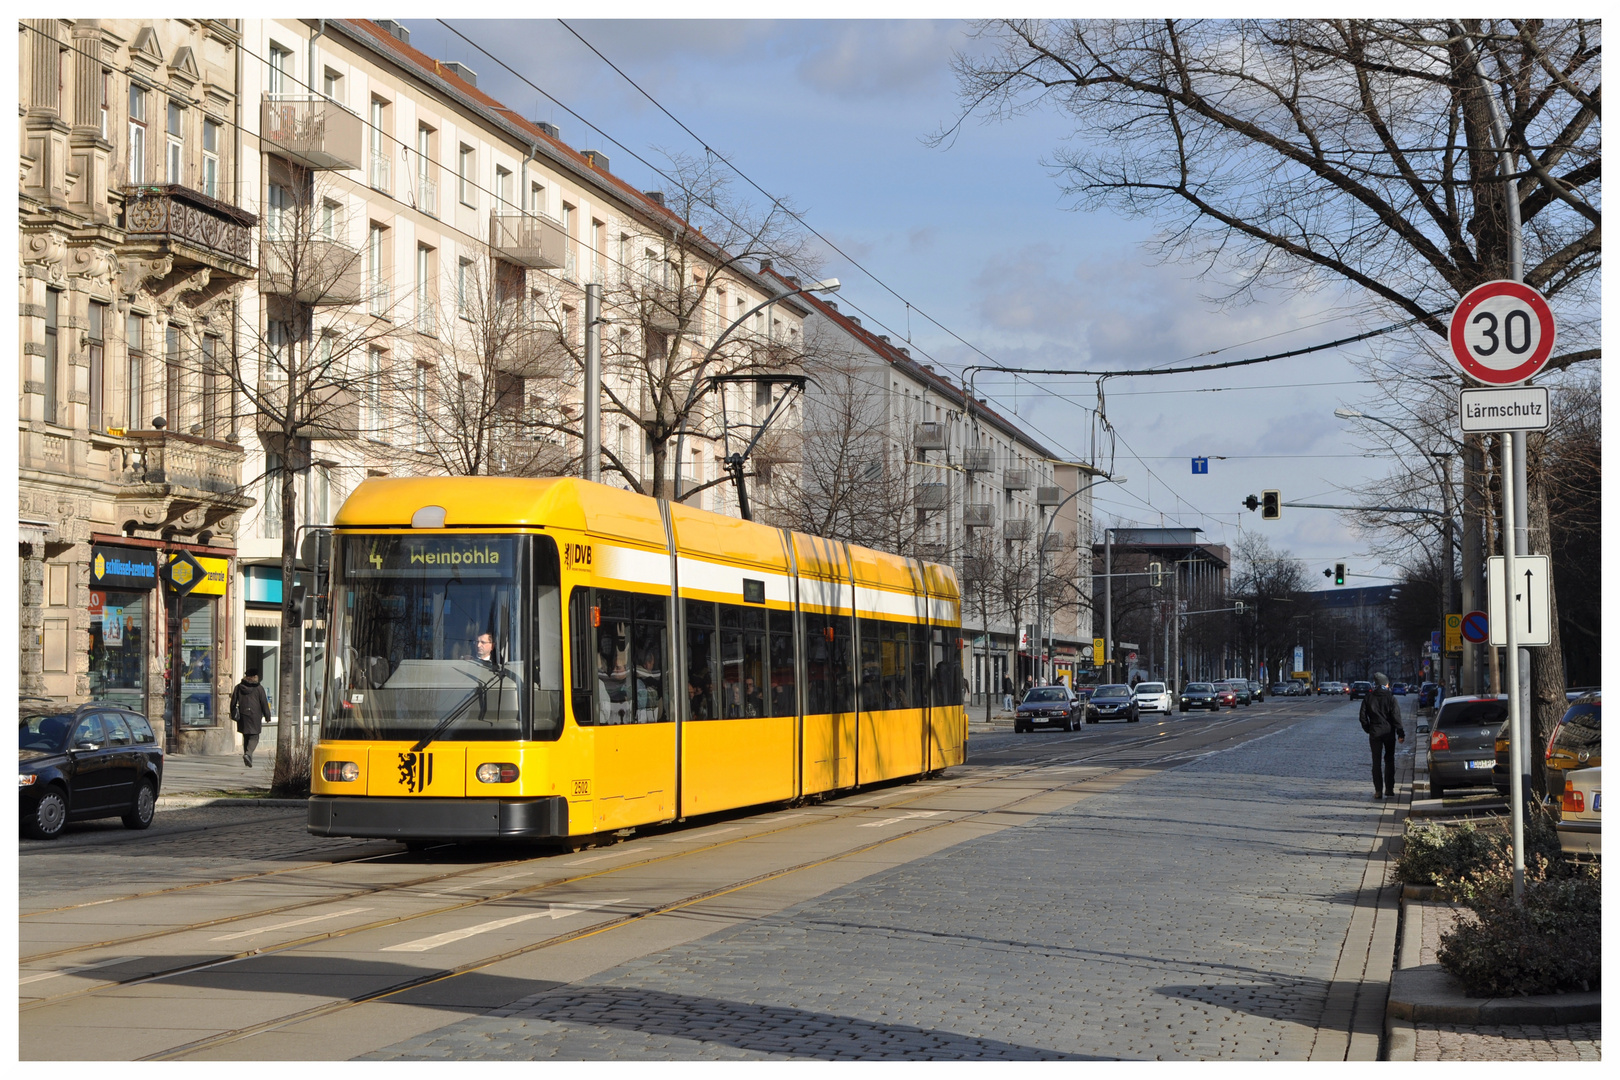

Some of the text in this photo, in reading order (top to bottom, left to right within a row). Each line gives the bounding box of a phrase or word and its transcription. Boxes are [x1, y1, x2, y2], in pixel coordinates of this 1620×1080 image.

[1472, 309, 1531, 356] 30
[1467, 401, 1542, 418] Lärmschutz
[369, 541, 383, 570] 4
[410, 545, 500, 565] Weinböhla
[575, 543, 592, 565] DVB
[105, 558, 155, 578] schlüssel-zentrale
[574, 781, 589, 794] 2502
